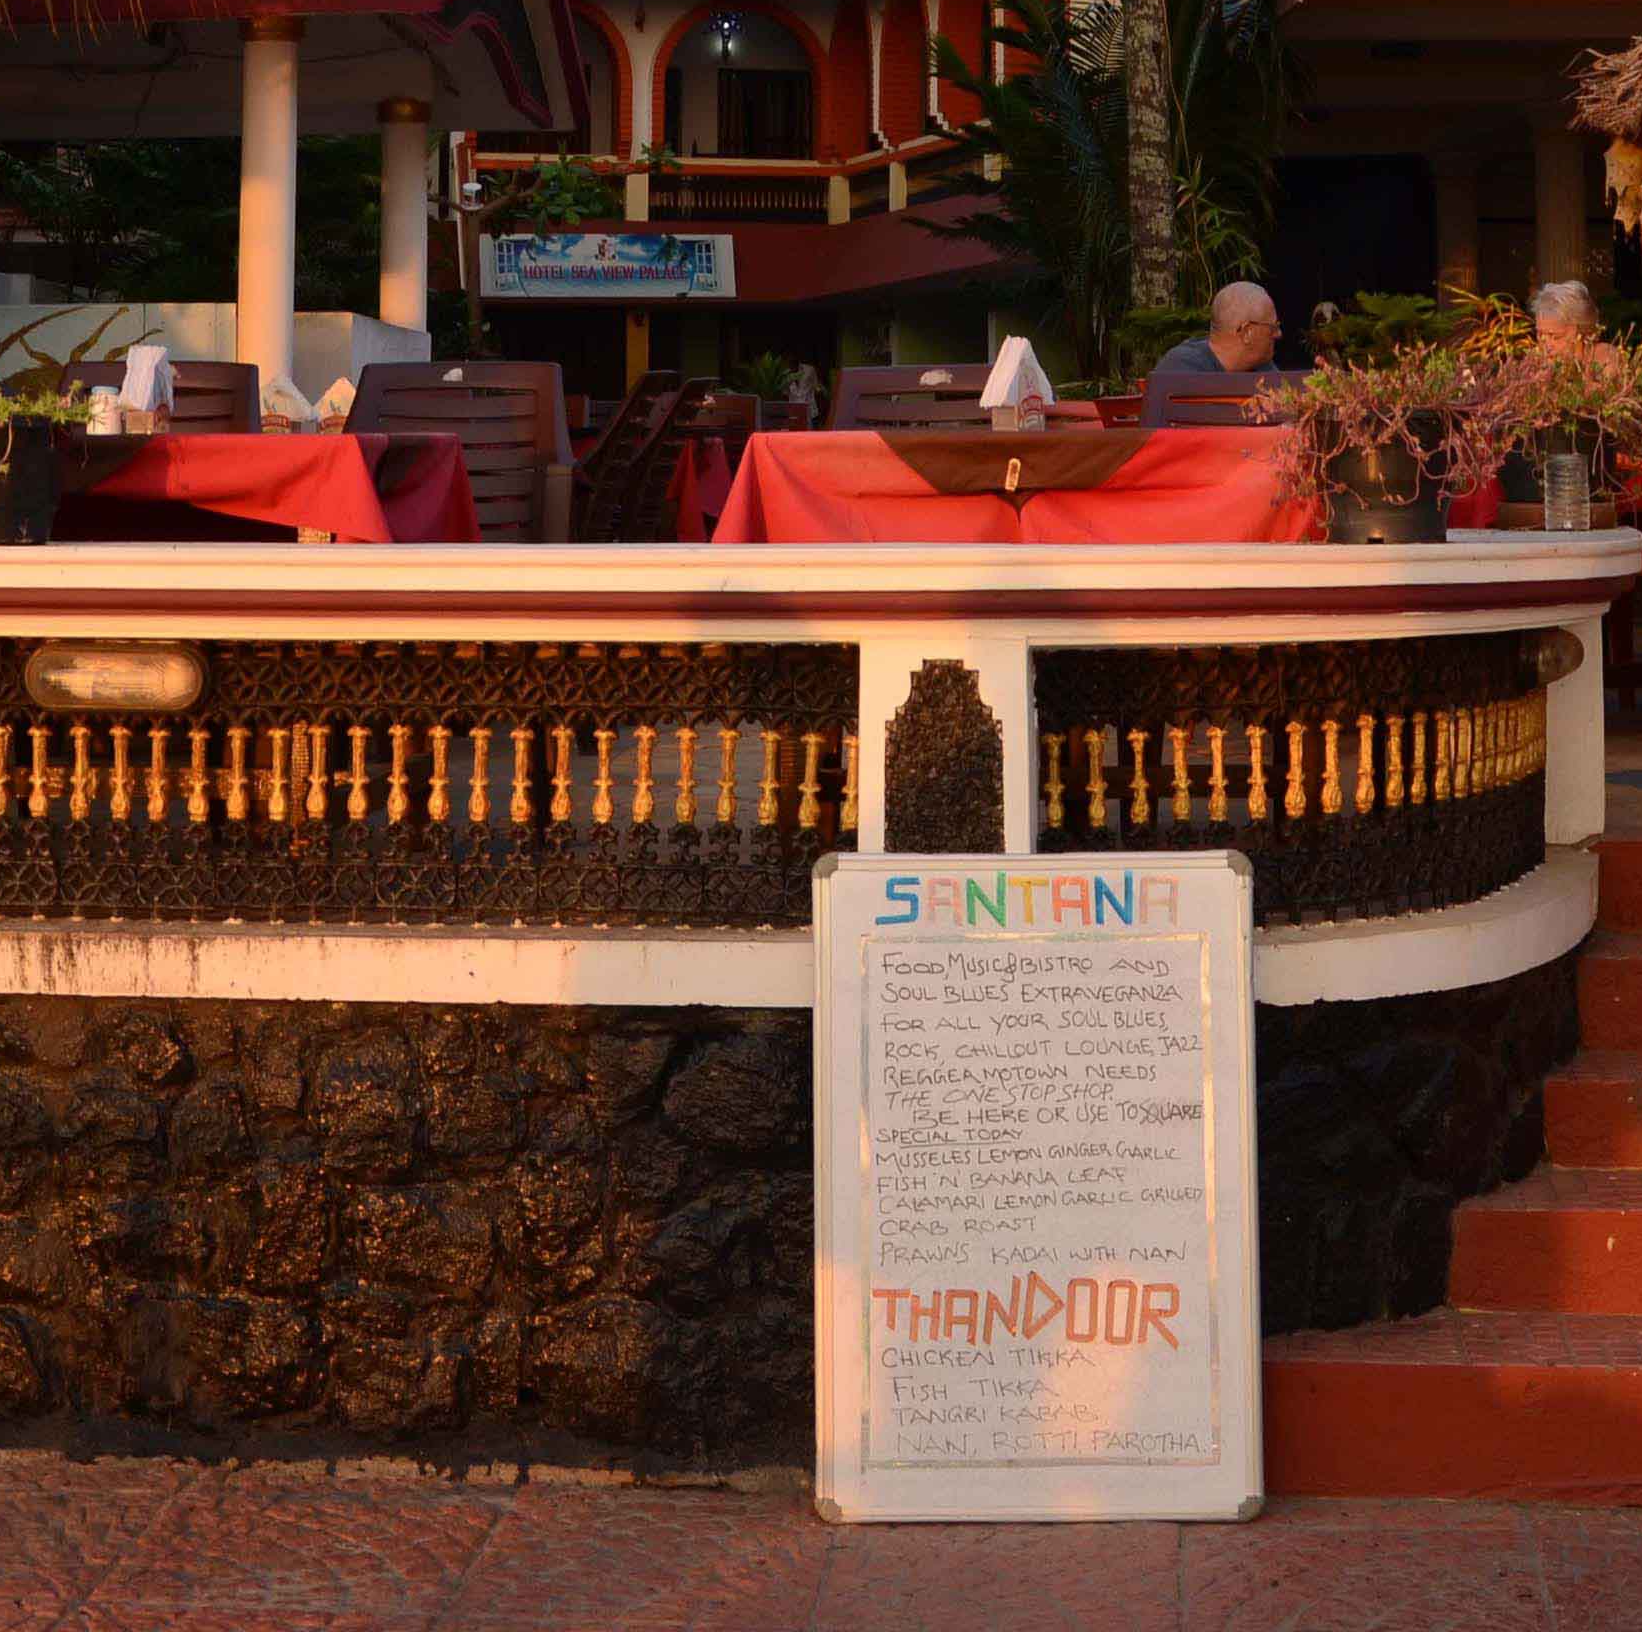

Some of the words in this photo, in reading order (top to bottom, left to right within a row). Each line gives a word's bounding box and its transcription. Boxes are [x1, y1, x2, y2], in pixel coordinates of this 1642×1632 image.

[524, 265, 566, 280] HOTEL
[571, 265, 597, 280] SEA
[601, 265, 634, 280] VIEW
[639, 265, 688, 281] PALACE
[875, 870, 1179, 927] SANTANA
[1109, 959, 1169, 978] AND
[881, 983, 937, 1003] SOUL
[944, 984, 1008, 1003] BLUES
[1021, 987, 1182, 1004] EXTRAVEGANZA
[881, 1013, 926, 1033] FOR
[935, 1016, 981, 1031] ALL
[992, 1014, 1049, 1034] YOUR
[1058, 1011, 1107, 1029] SOUL
[956, 1040, 1052, 1059] CHILLOUT
[1158, 1035, 1203, 1052] JAZZ
[983, 1065, 1067, 1090] MOTOWN
[1085, 1064, 1156, 1081] NEEDS
[885, 1091, 931, 1111] THE
[942, 1087, 994, 1104] ONE
[913, 1109, 959, 1129] BE
[968, 1108, 1029, 1123] HERE
[1037, 1107, 1069, 1123] OR
[877, 1130, 957, 1145] SPECIAL
[966, 1128, 1023, 1142] TODAY
[876, 1149, 971, 1174] MUSSELES
[978, 1147, 1041, 1165] LEMON
[1048, 1144, 1111, 1159] GINGER
[1116, 1142, 1181, 1161] GARLIC
[877, 1175, 926, 1193] FISH
[971, 1169, 1057, 1187] BANANA
[1068, 1167, 1126, 1183] LEAF
[879, 1196, 985, 1214] CALAMARI
[994, 1192, 1056, 1210] LEMON
[1061, 1190, 1133, 1205] GARLIC
[1140, 1187, 1203, 1203] GRILLED
[879, 1220, 948, 1237] CRAB
[964, 1216, 1036, 1234] ROAST
[880, 1242, 970, 1266] PRAWNS
[992, 1246, 1057, 1264] KADAI
[1070, 1246, 1116, 1260] WITH
[1129, 1242, 1187, 1261] NAN
[871, 1270, 1181, 1349] THANDOOR
[881, 1348, 995, 1368] CHICKEN
[1008, 1348, 1095, 1367] TIKKA
[893, 1376, 948, 1403] FISH
[893, 1406, 987, 1425] TANGRI
